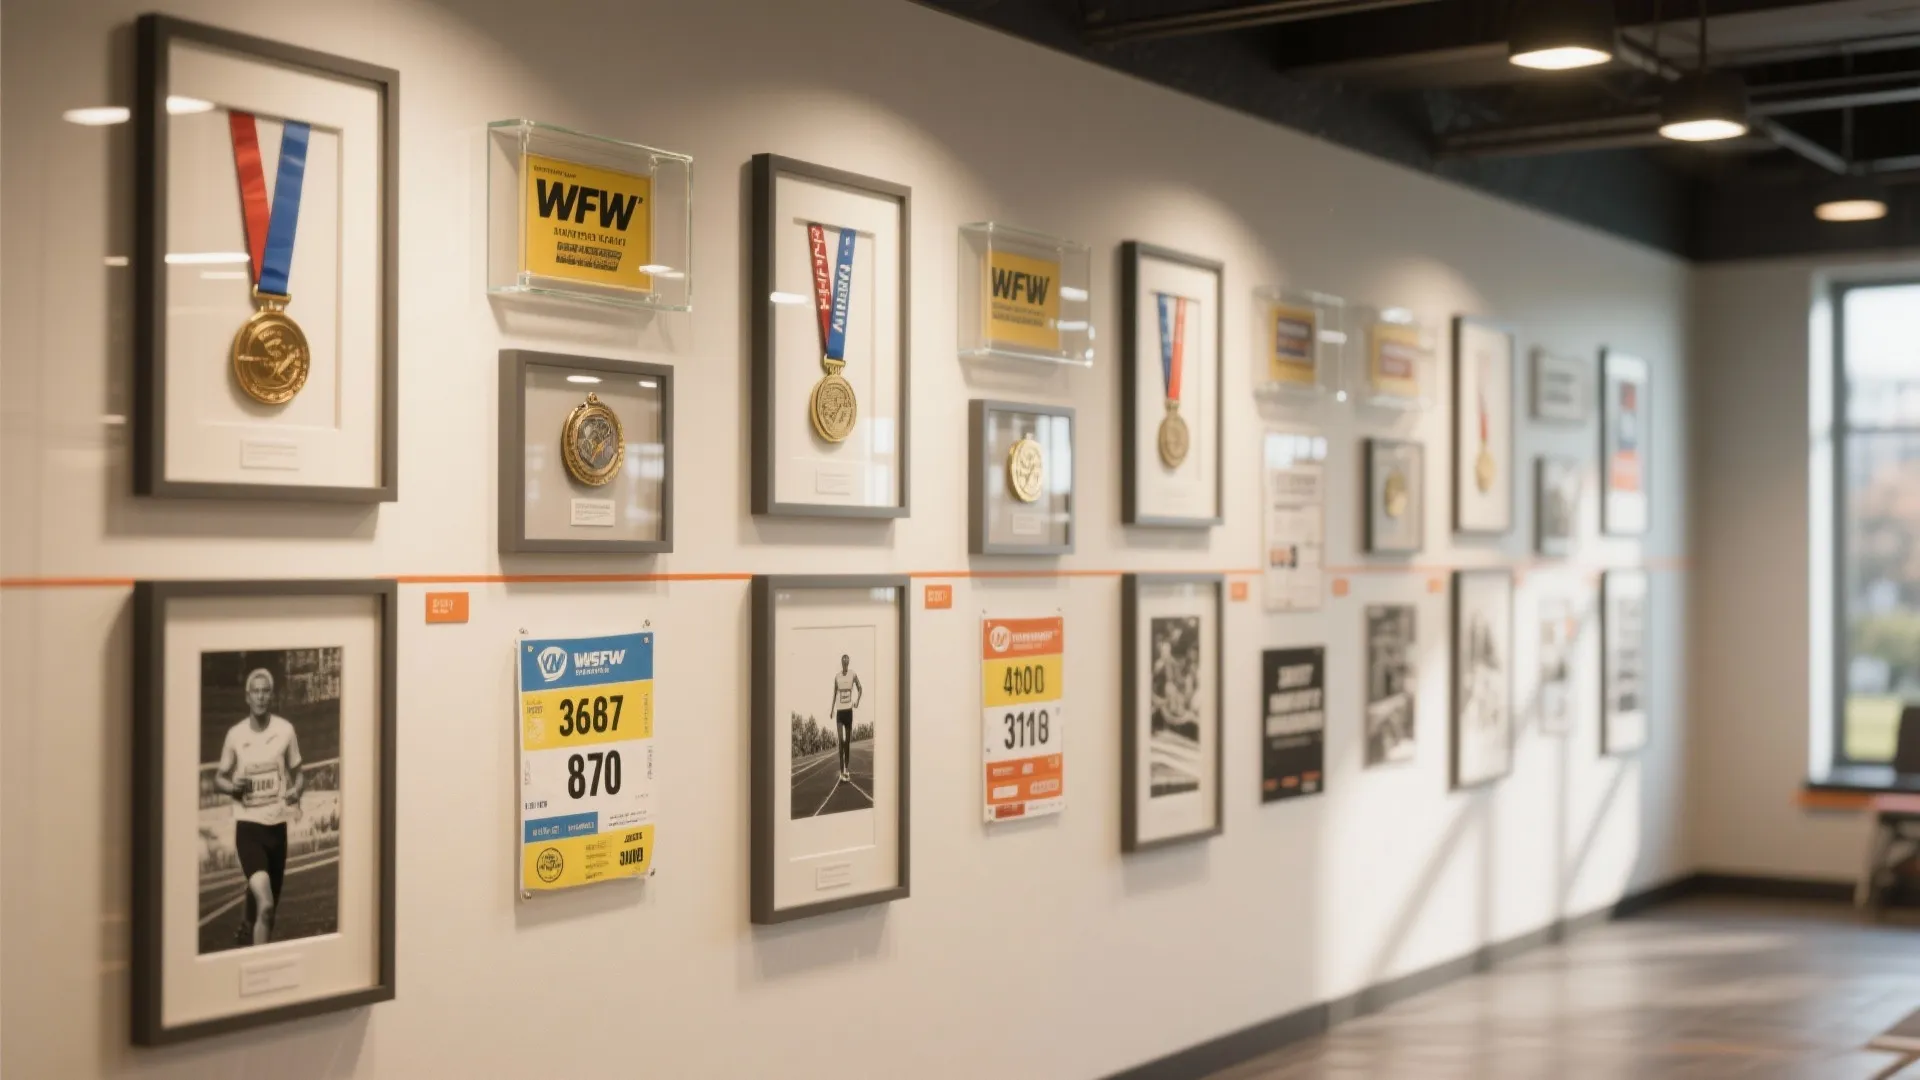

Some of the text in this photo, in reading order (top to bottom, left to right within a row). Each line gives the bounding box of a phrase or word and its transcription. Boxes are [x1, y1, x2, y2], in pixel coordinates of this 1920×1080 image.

[991, 266, 1050, 306] WFW
[559, 694, 624, 737] 3687
[1004, 709, 1049, 750] 3118
[567, 750, 622, 799] 870
